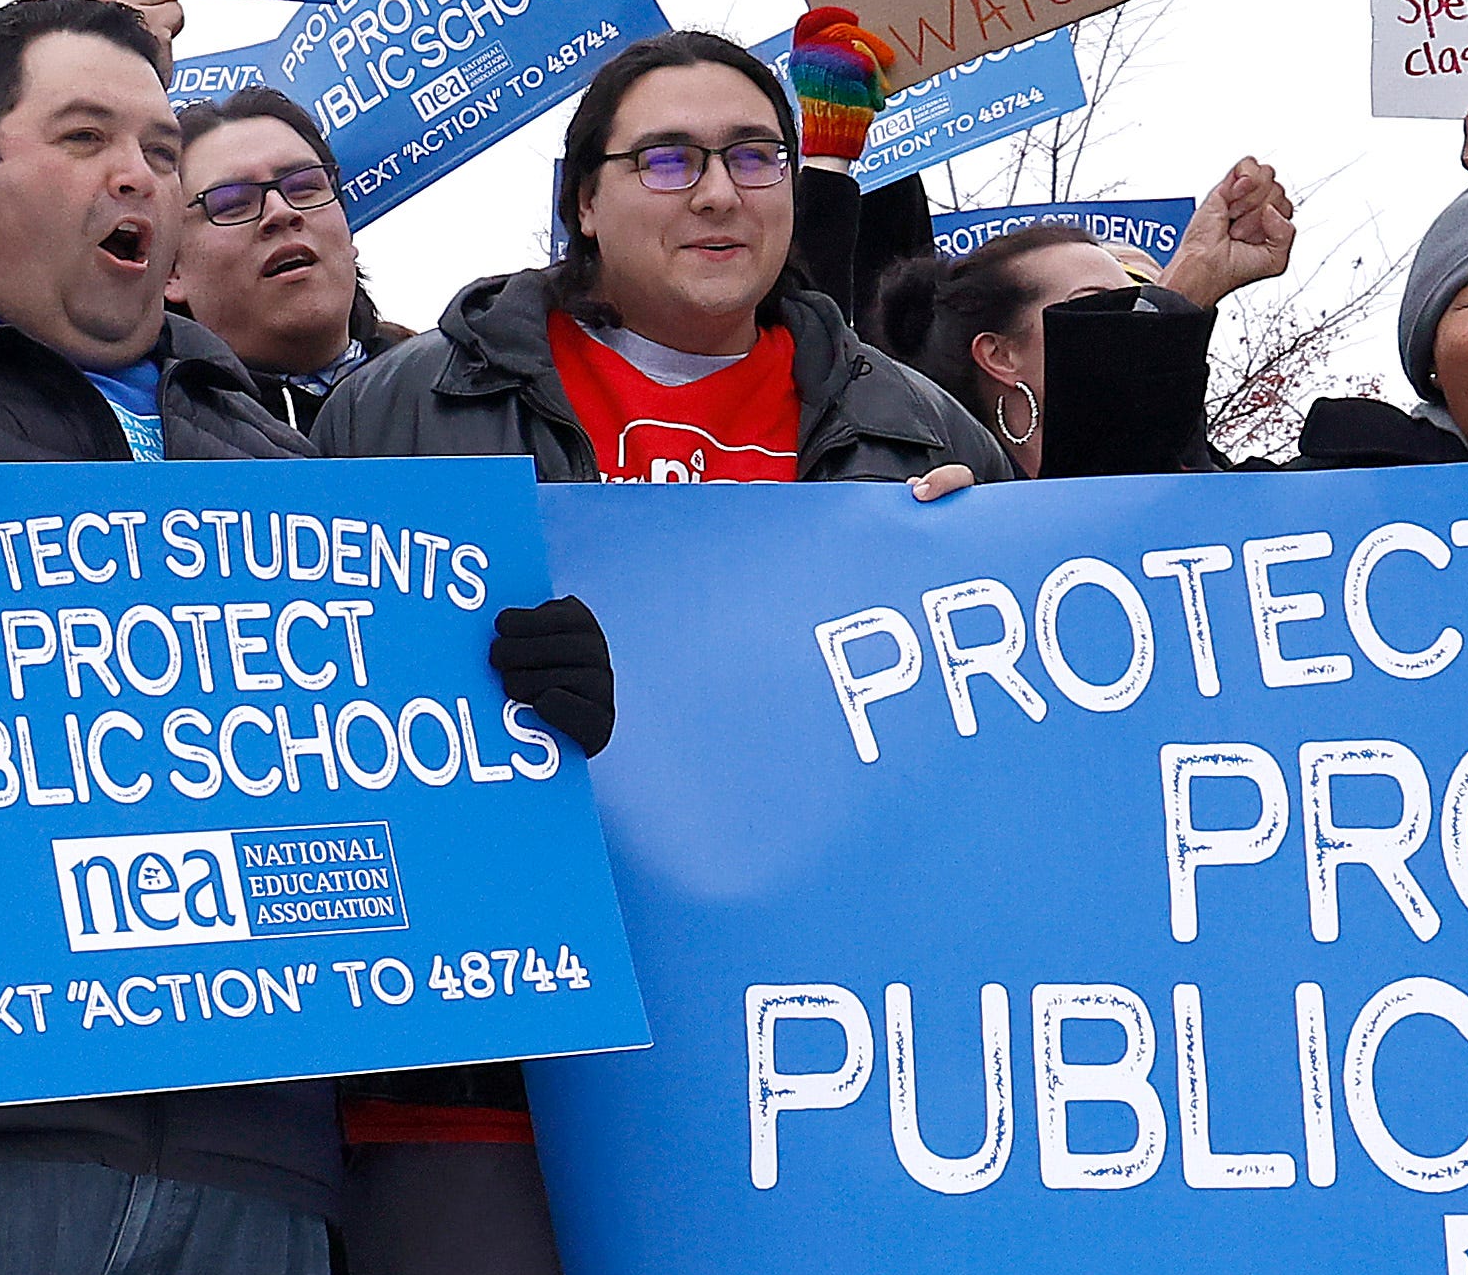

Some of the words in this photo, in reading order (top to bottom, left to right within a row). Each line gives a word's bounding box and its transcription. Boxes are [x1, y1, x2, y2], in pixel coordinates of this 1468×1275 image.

[311, 46, 417, 141] UBLIC
[343, 152, 403, 203] TEXT
[402, 89, 502, 164] "ACTION"
[507, 66, 545, 98] TO
[546, 20, 621, 74] 48744
[417, 75, 465, 116] nea
[873, 113, 911, 142] nea
[943, 114, 974, 137] TO
[979, 87, 1044, 123] 48744
[164, 509, 489, 610] STUDENTS
[0, 601, 374, 700] PROTECT
[167, 698, 560, 800] SCHOOLS
[70, 849, 236, 935] nea
[242, 837, 383, 867] NATIONAL
[248, 868, 389, 898] EDUCATION
[257, 896, 394, 925] ASSOCIATION
[65, 964, 317, 1030] "ACTION"
[332, 956, 413, 1009] TO
[428, 946, 589, 1001] 48744
